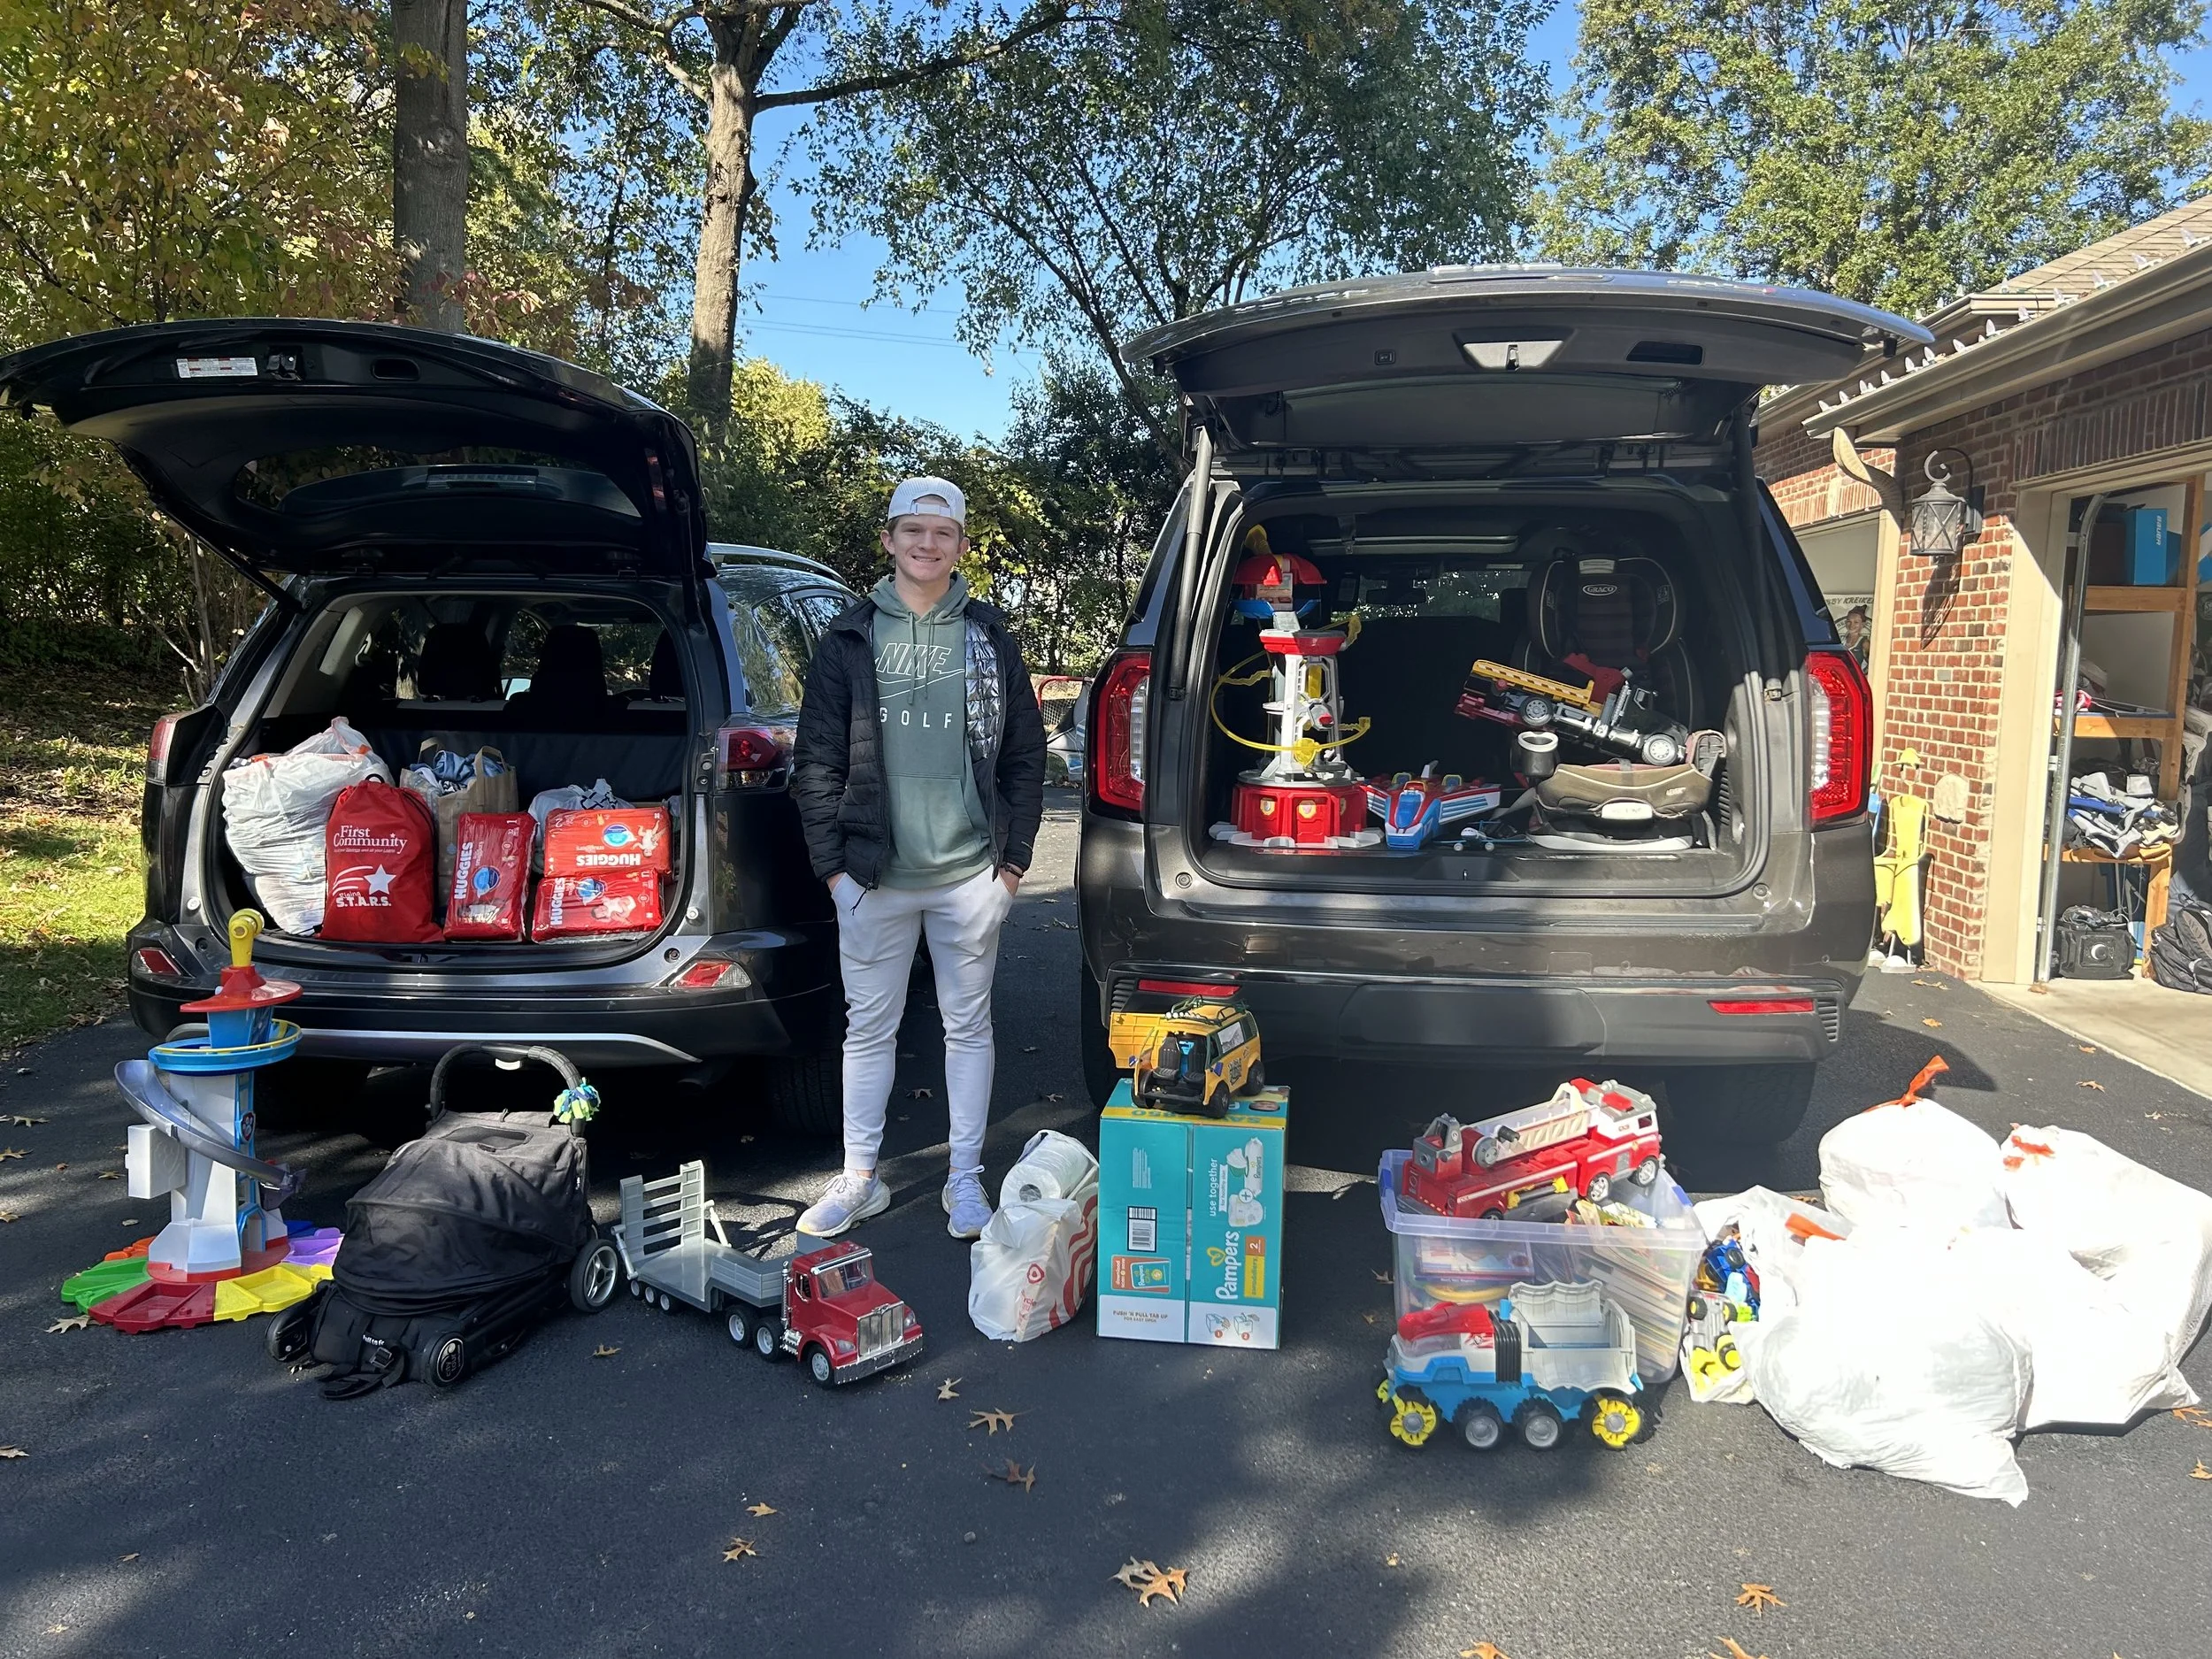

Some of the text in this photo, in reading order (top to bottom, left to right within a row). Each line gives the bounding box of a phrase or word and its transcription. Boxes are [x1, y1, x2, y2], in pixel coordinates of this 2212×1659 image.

[876, 642, 952, 678] NIKE
[879, 707, 953, 728] GOLF
[334, 833, 408, 854] Community
[340, 825, 371, 838] First
[454, 841, 474, 900] HUGGIES
[576, 853, 641, 866] HUGGIES
[336, 896, 392, 908] S.T.A.R.S.
[550, 877, 565, 926] HUGGIES
[1208, 1158, 1219, 1198] together
[1216, 1230, 1241, 1300] Pampers
